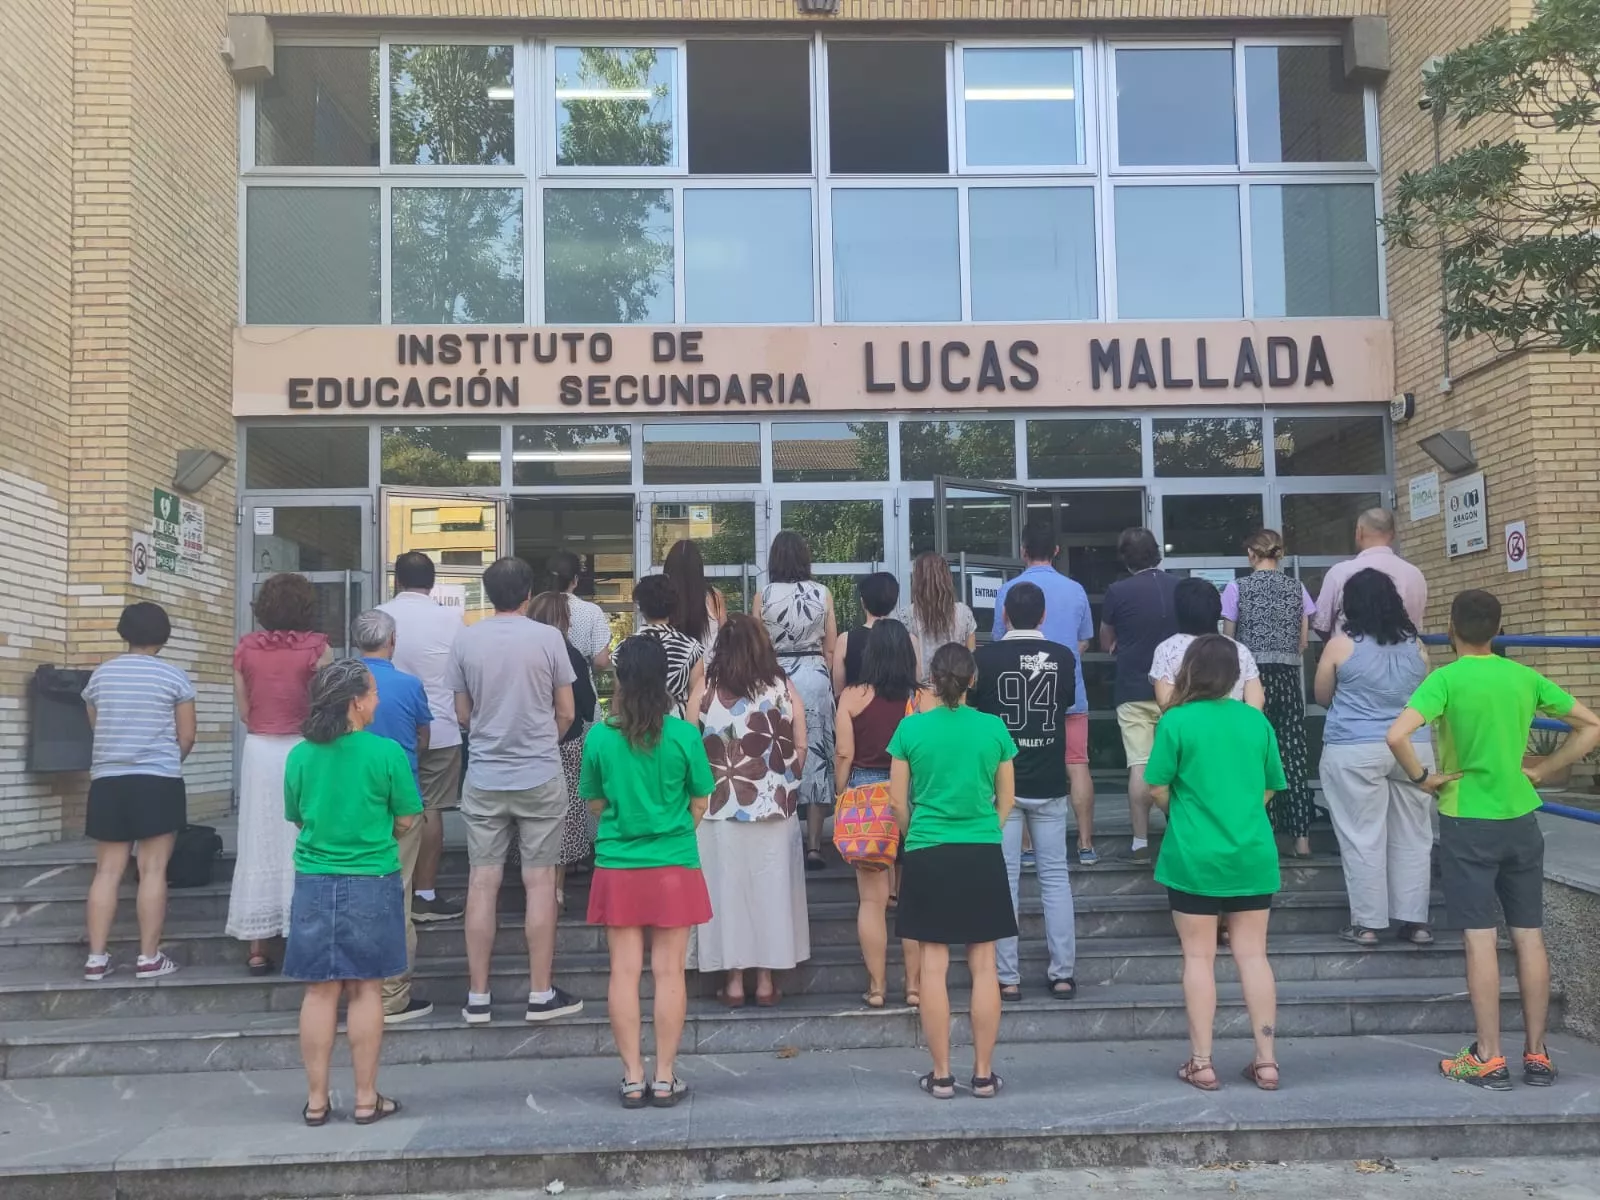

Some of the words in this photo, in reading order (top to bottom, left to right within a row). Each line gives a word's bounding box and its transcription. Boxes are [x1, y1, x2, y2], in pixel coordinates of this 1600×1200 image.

[398, 332, 613, 365] INSTITUTO
[652, 331, 704, 363] DE
[864, 340, 1040, 394] LUCAS
[1090, 335, 1335, 391] MALLADA
[288, 368, 520, 410] EDUCACIÓN
[559, 372, 812, 412] SECUNDARIA
[975, 587, 998, 599] ENTRAD
[997, 671, 1058, 731] 94
